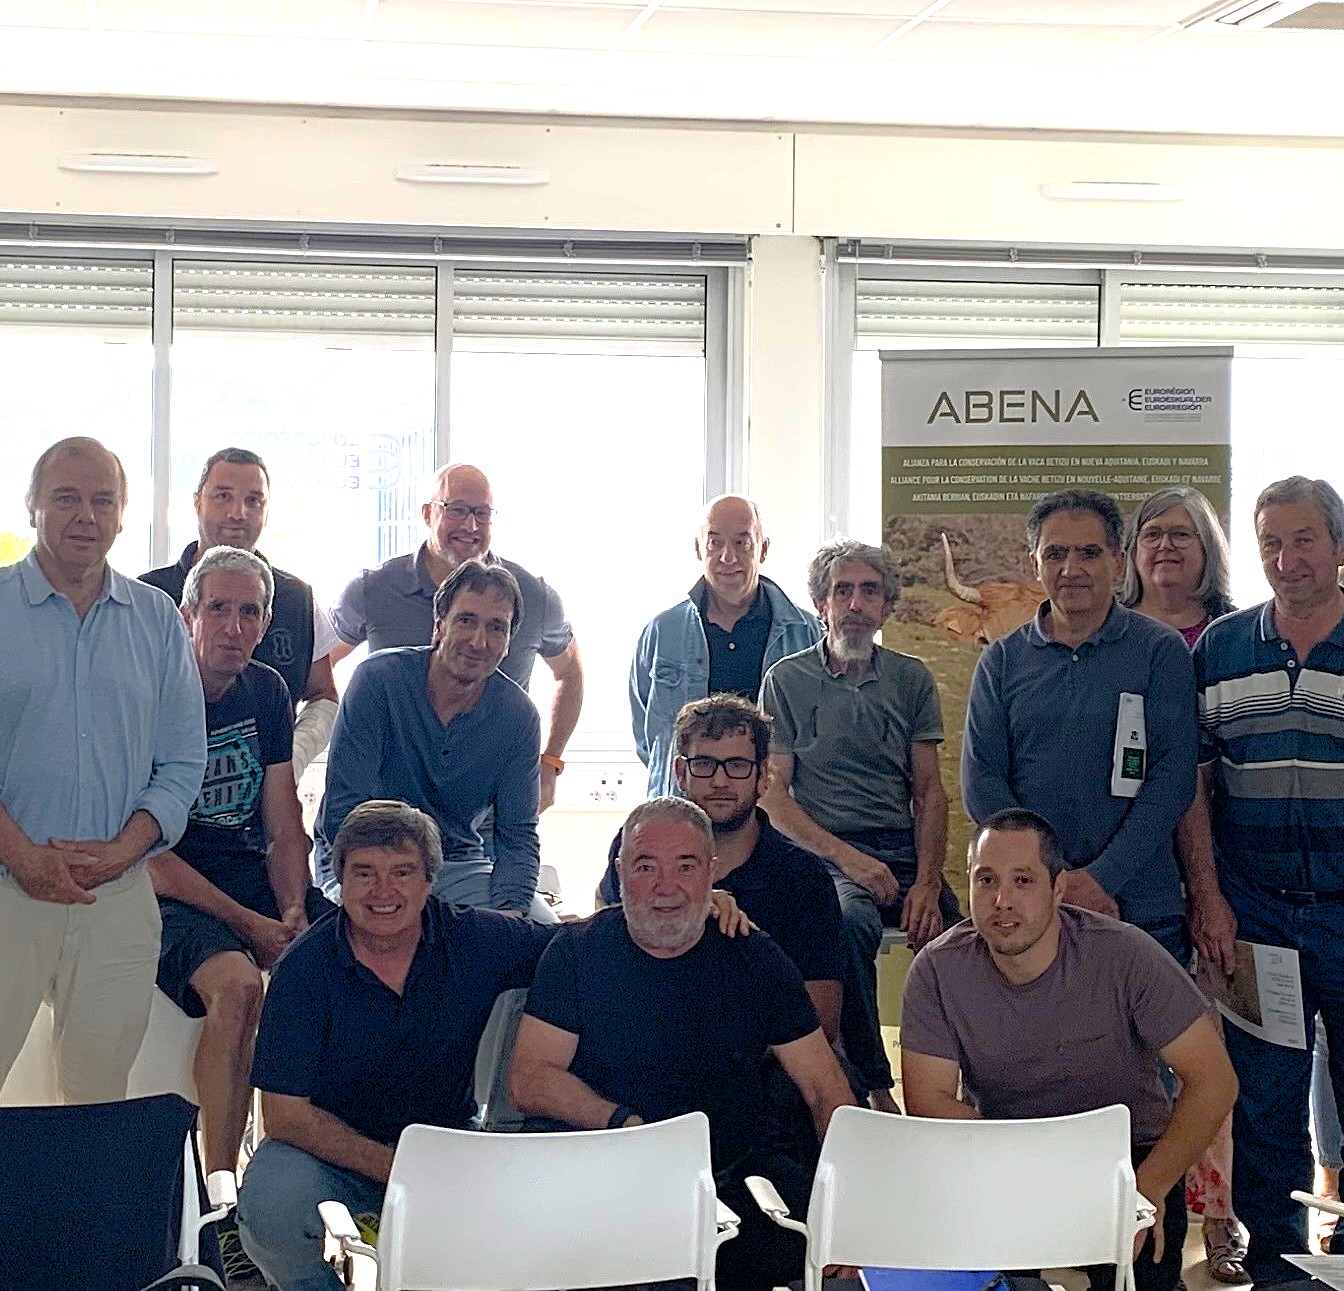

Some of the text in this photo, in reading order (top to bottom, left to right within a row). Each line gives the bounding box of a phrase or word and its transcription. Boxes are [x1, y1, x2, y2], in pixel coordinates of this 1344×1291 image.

[927, 388, 1100, 424] ABENA
[903, 458, 930, 466] ALIANZA
[931, 458, 947, 466] PARA
[949, 458, 957, 466] LA
[1018, 458, 1026, 466] LA
[890, 476, 921, 484] ALLIANCE
[941, 476, 949, 484] LA
[1009, 476, 1018, 484] LA
[1006, 493, 1018, 501] ETA
